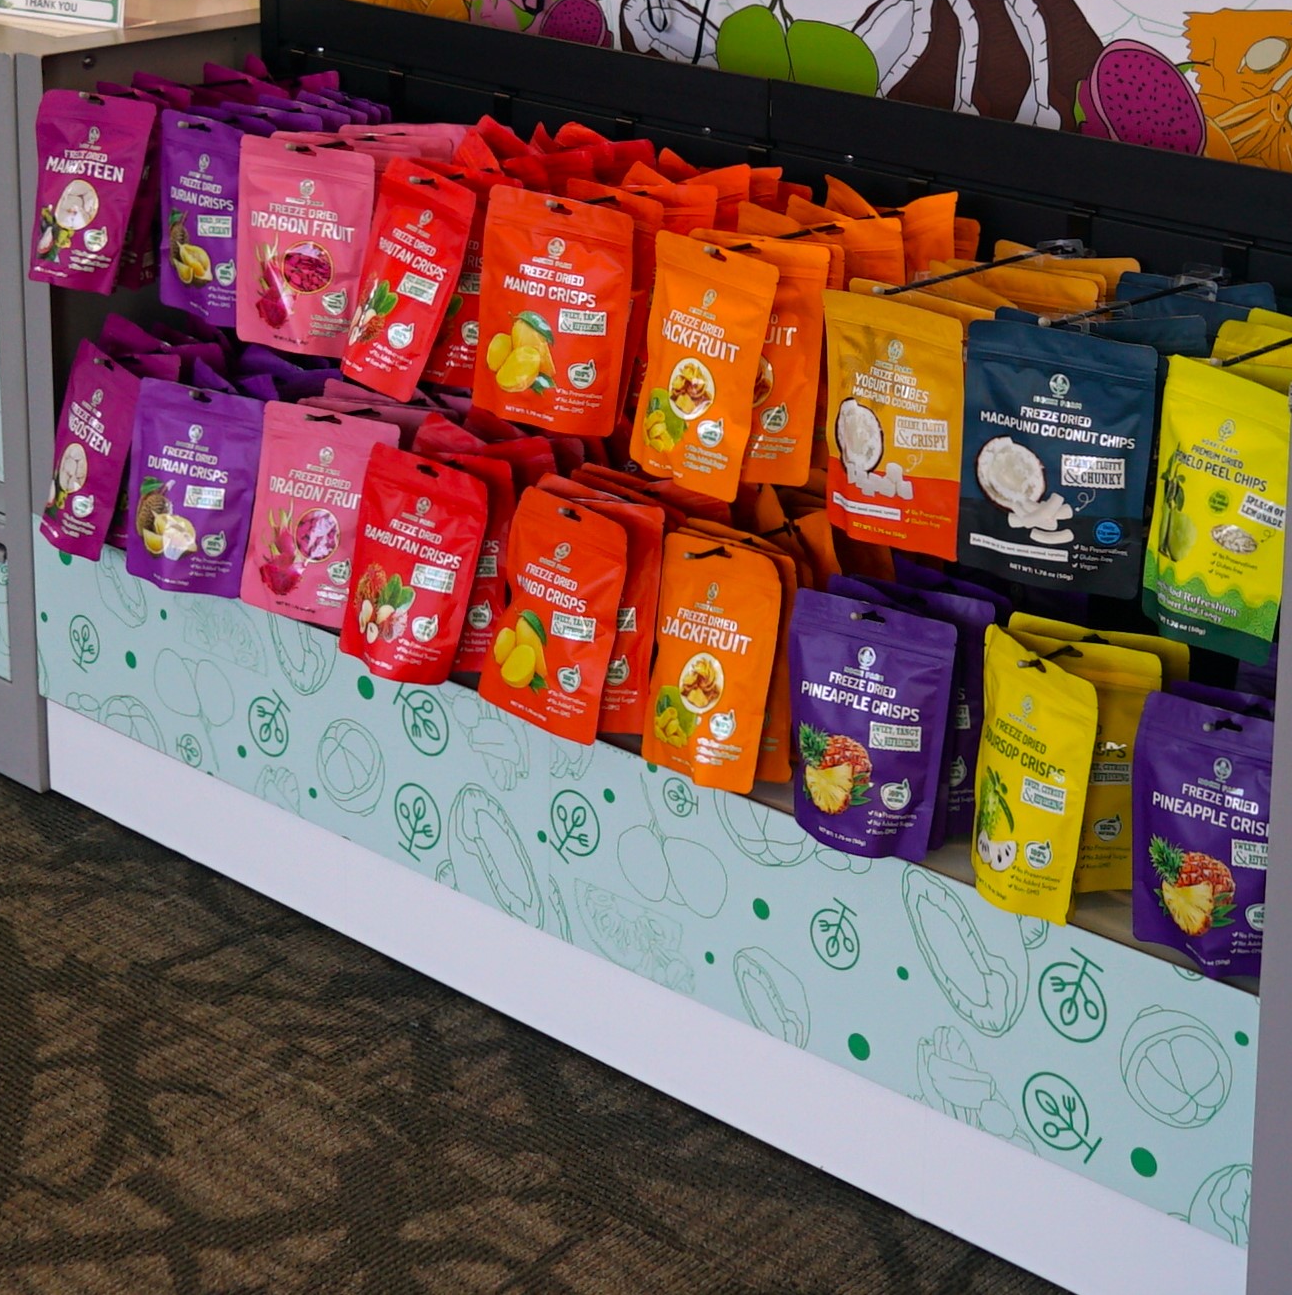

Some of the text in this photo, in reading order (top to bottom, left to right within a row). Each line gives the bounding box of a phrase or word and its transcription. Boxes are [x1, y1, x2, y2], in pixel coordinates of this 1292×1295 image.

[59, 1, 77, 12] YOU
[170, 186, 234, 212] DURIAN CRISPS
[269, 202, 338, 222] FREEZE DRIED
[251, 211, 308, 235] DRAGON
[312, 221, 355, 243] FRUIT
[519, 264, 584, 287] FREEZE DRIED
[504, 275, 596, 307] MANGO CRISPS
[670, 309, 725, 339] FREEZE DRIED
[853, 386, 927, 413] MACAPUNO COCONUT
[855, 372, 929, 404] YOGURT CUBES
[980, 411, 1135, 449] MACAPUNO COCONUT CHIPS
[1020, 406, 1091, 428] FREEZE DRIED
[896, 429, 946, 448] & CRISPY
[163, 445, 218, 465] FREEZE DRIED
[1192, 444, 1243, 469] PREMIUM DRIED
[148, 455, 228, 484] DURIAN CRISPS
[289, 469, 351, 490] FREEZE DRIED
[1064, 469, 1122, 484] & CHUNKY
[1205, 462, 1231, 481] PEEL
[1234, 472, 1267, 492] CHIPS
[270, 476, 321, 501] DRAGON
[1241, 505, 1282, 528] LEMONADE
[389, 519, 442, 544] FREEZE DRIED
[365, 524, 461, 569] RAMBUTAN CRISPS
[525, 563, 577, 592] FREEZE DRIED
[677, 607, 738, 632] FREEZE DRIED
[662, 616, 752, 655] JACKFRUIT
[829, 671, 896, 699] FREEZE DRIED
[801, 680, 920, 722] PINEAPPLE CRISPS
[996, 719, 1046, 755] FREEZE DRIED
[1182, 783, 1258, 815] FREEZE DRIED
[1152, 791, 1268, 837] PINEAPPLE CRIS
